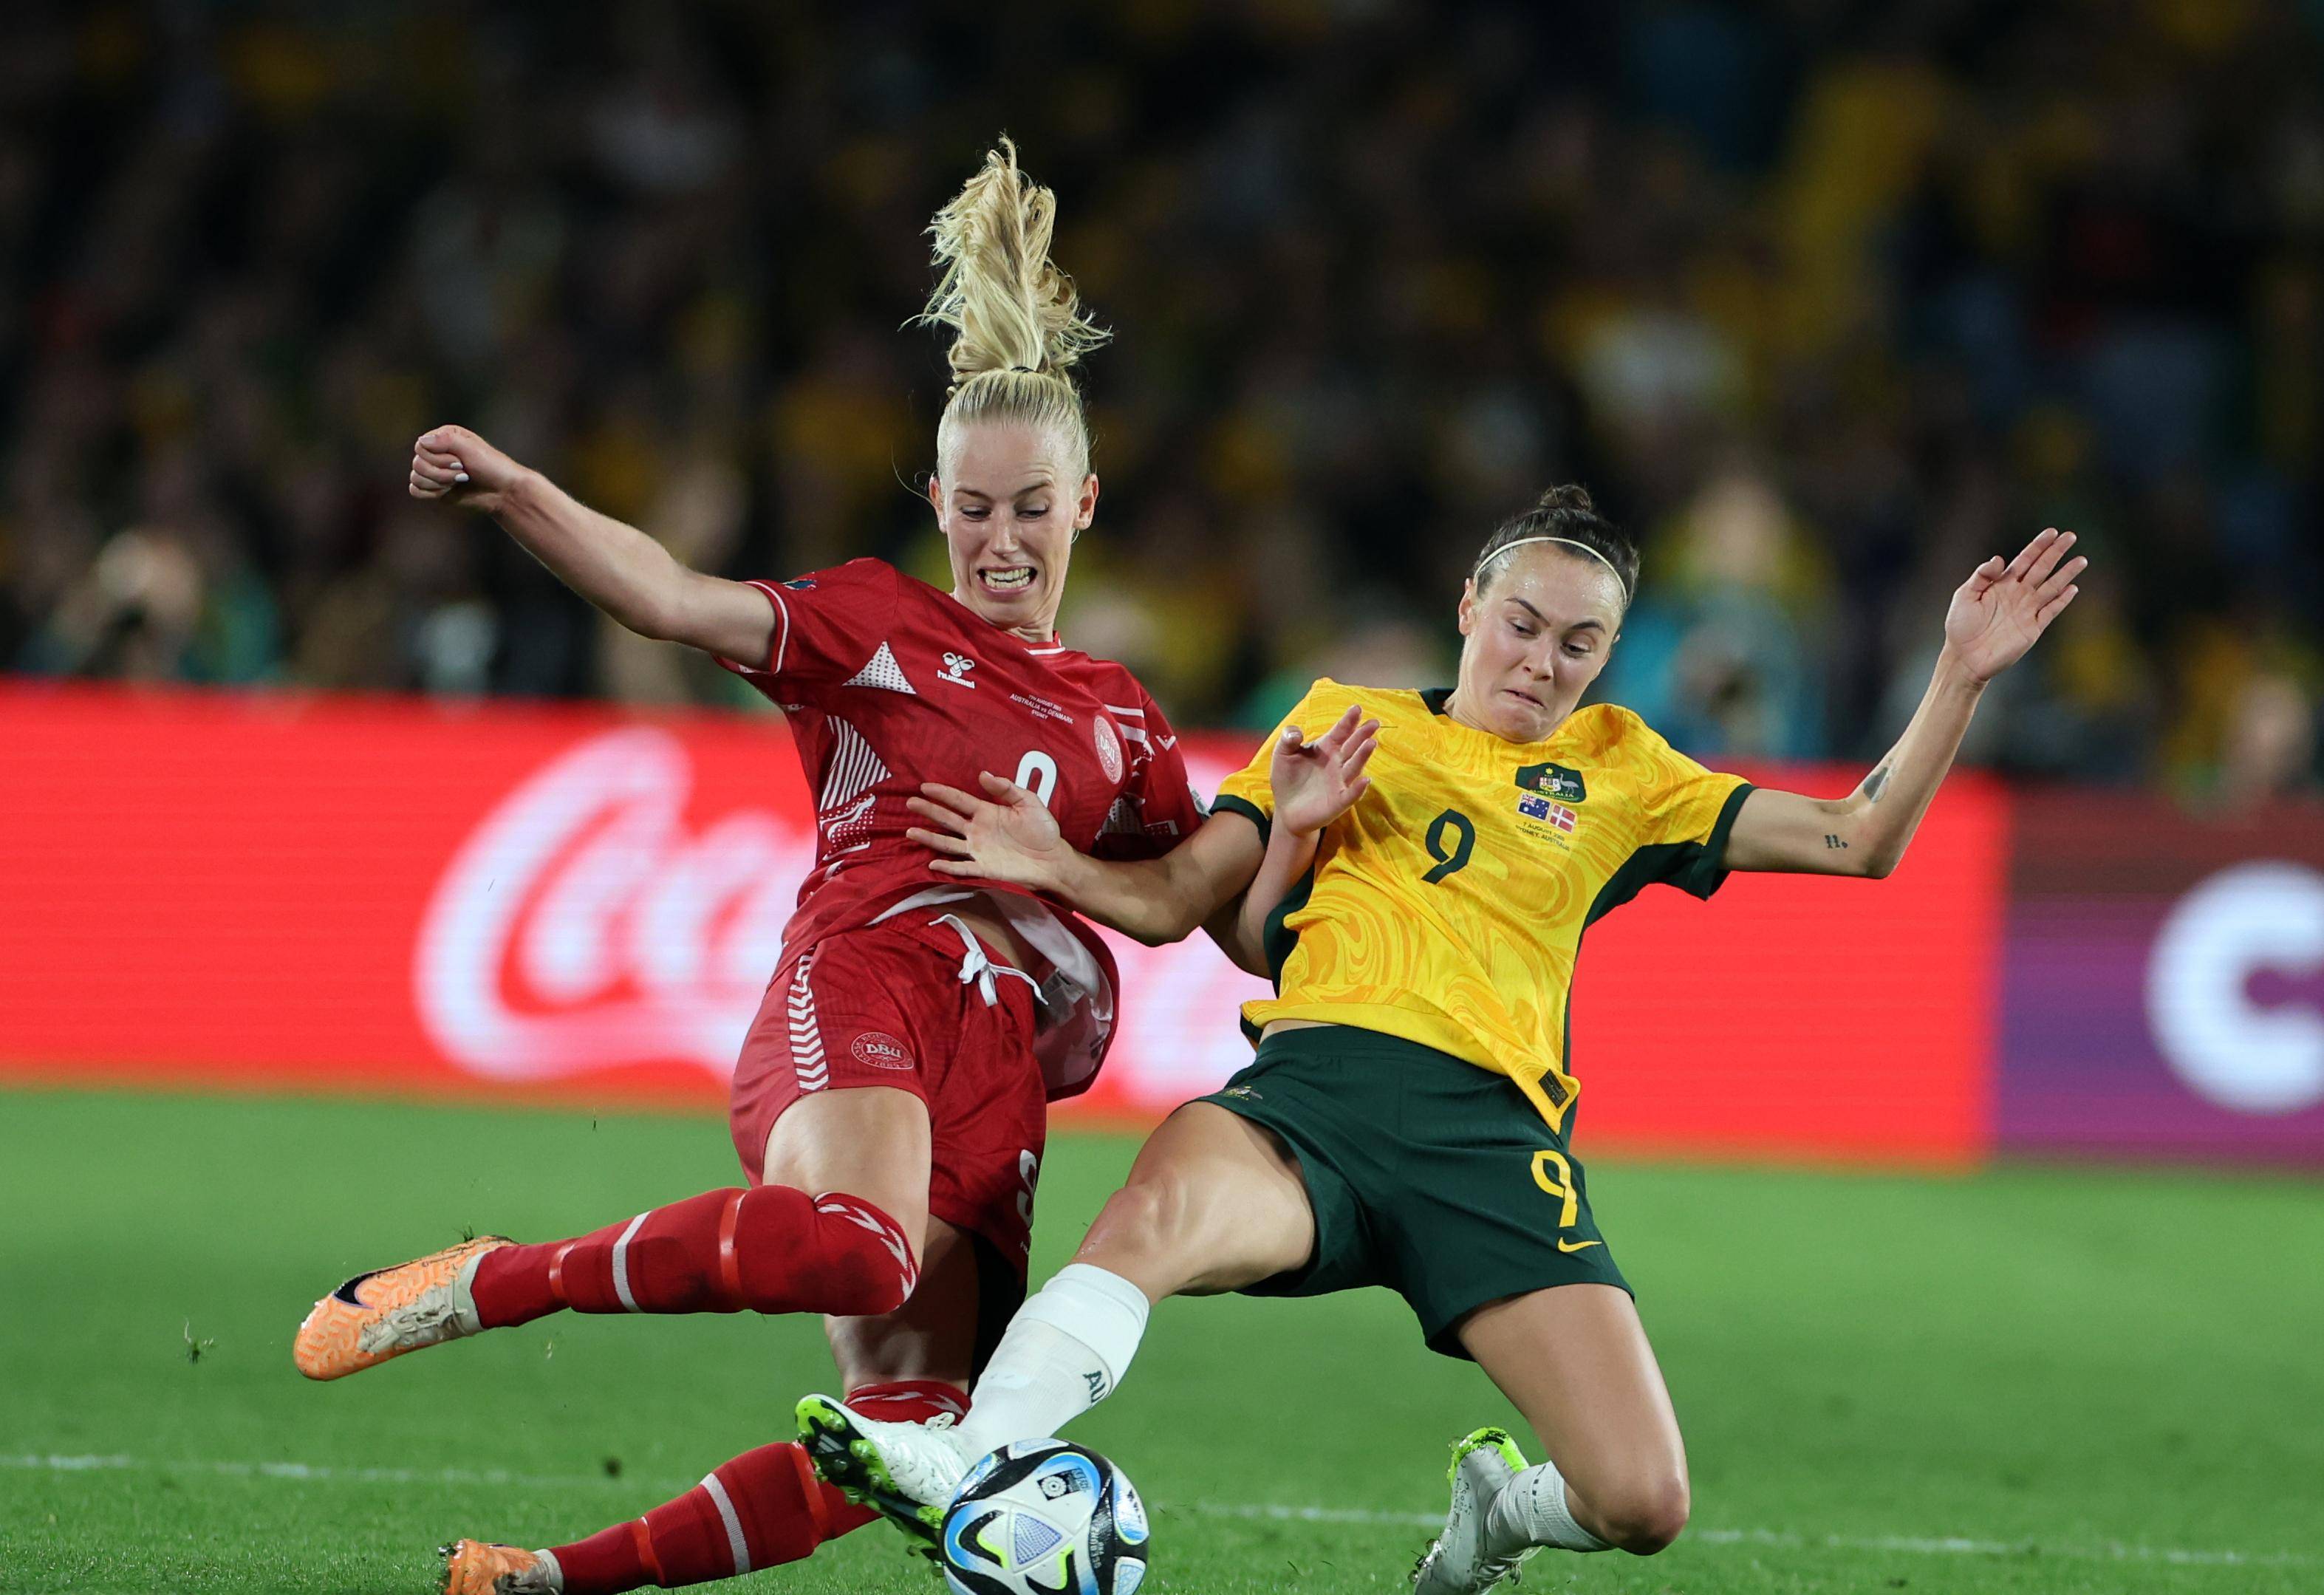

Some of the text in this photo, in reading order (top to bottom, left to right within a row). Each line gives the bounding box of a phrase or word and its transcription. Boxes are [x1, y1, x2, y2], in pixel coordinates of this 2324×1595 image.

[937, 669, 976, 689] hummel
[1009, 694, 1040, 710] AUSTRALIA
[1047, 709, 1074, 724] DENMARK
[1421, 808, 1476, 885] 9
[866, 1043, 903, 1059] DBU
[1531, 1150, 1578, 1227] 9
